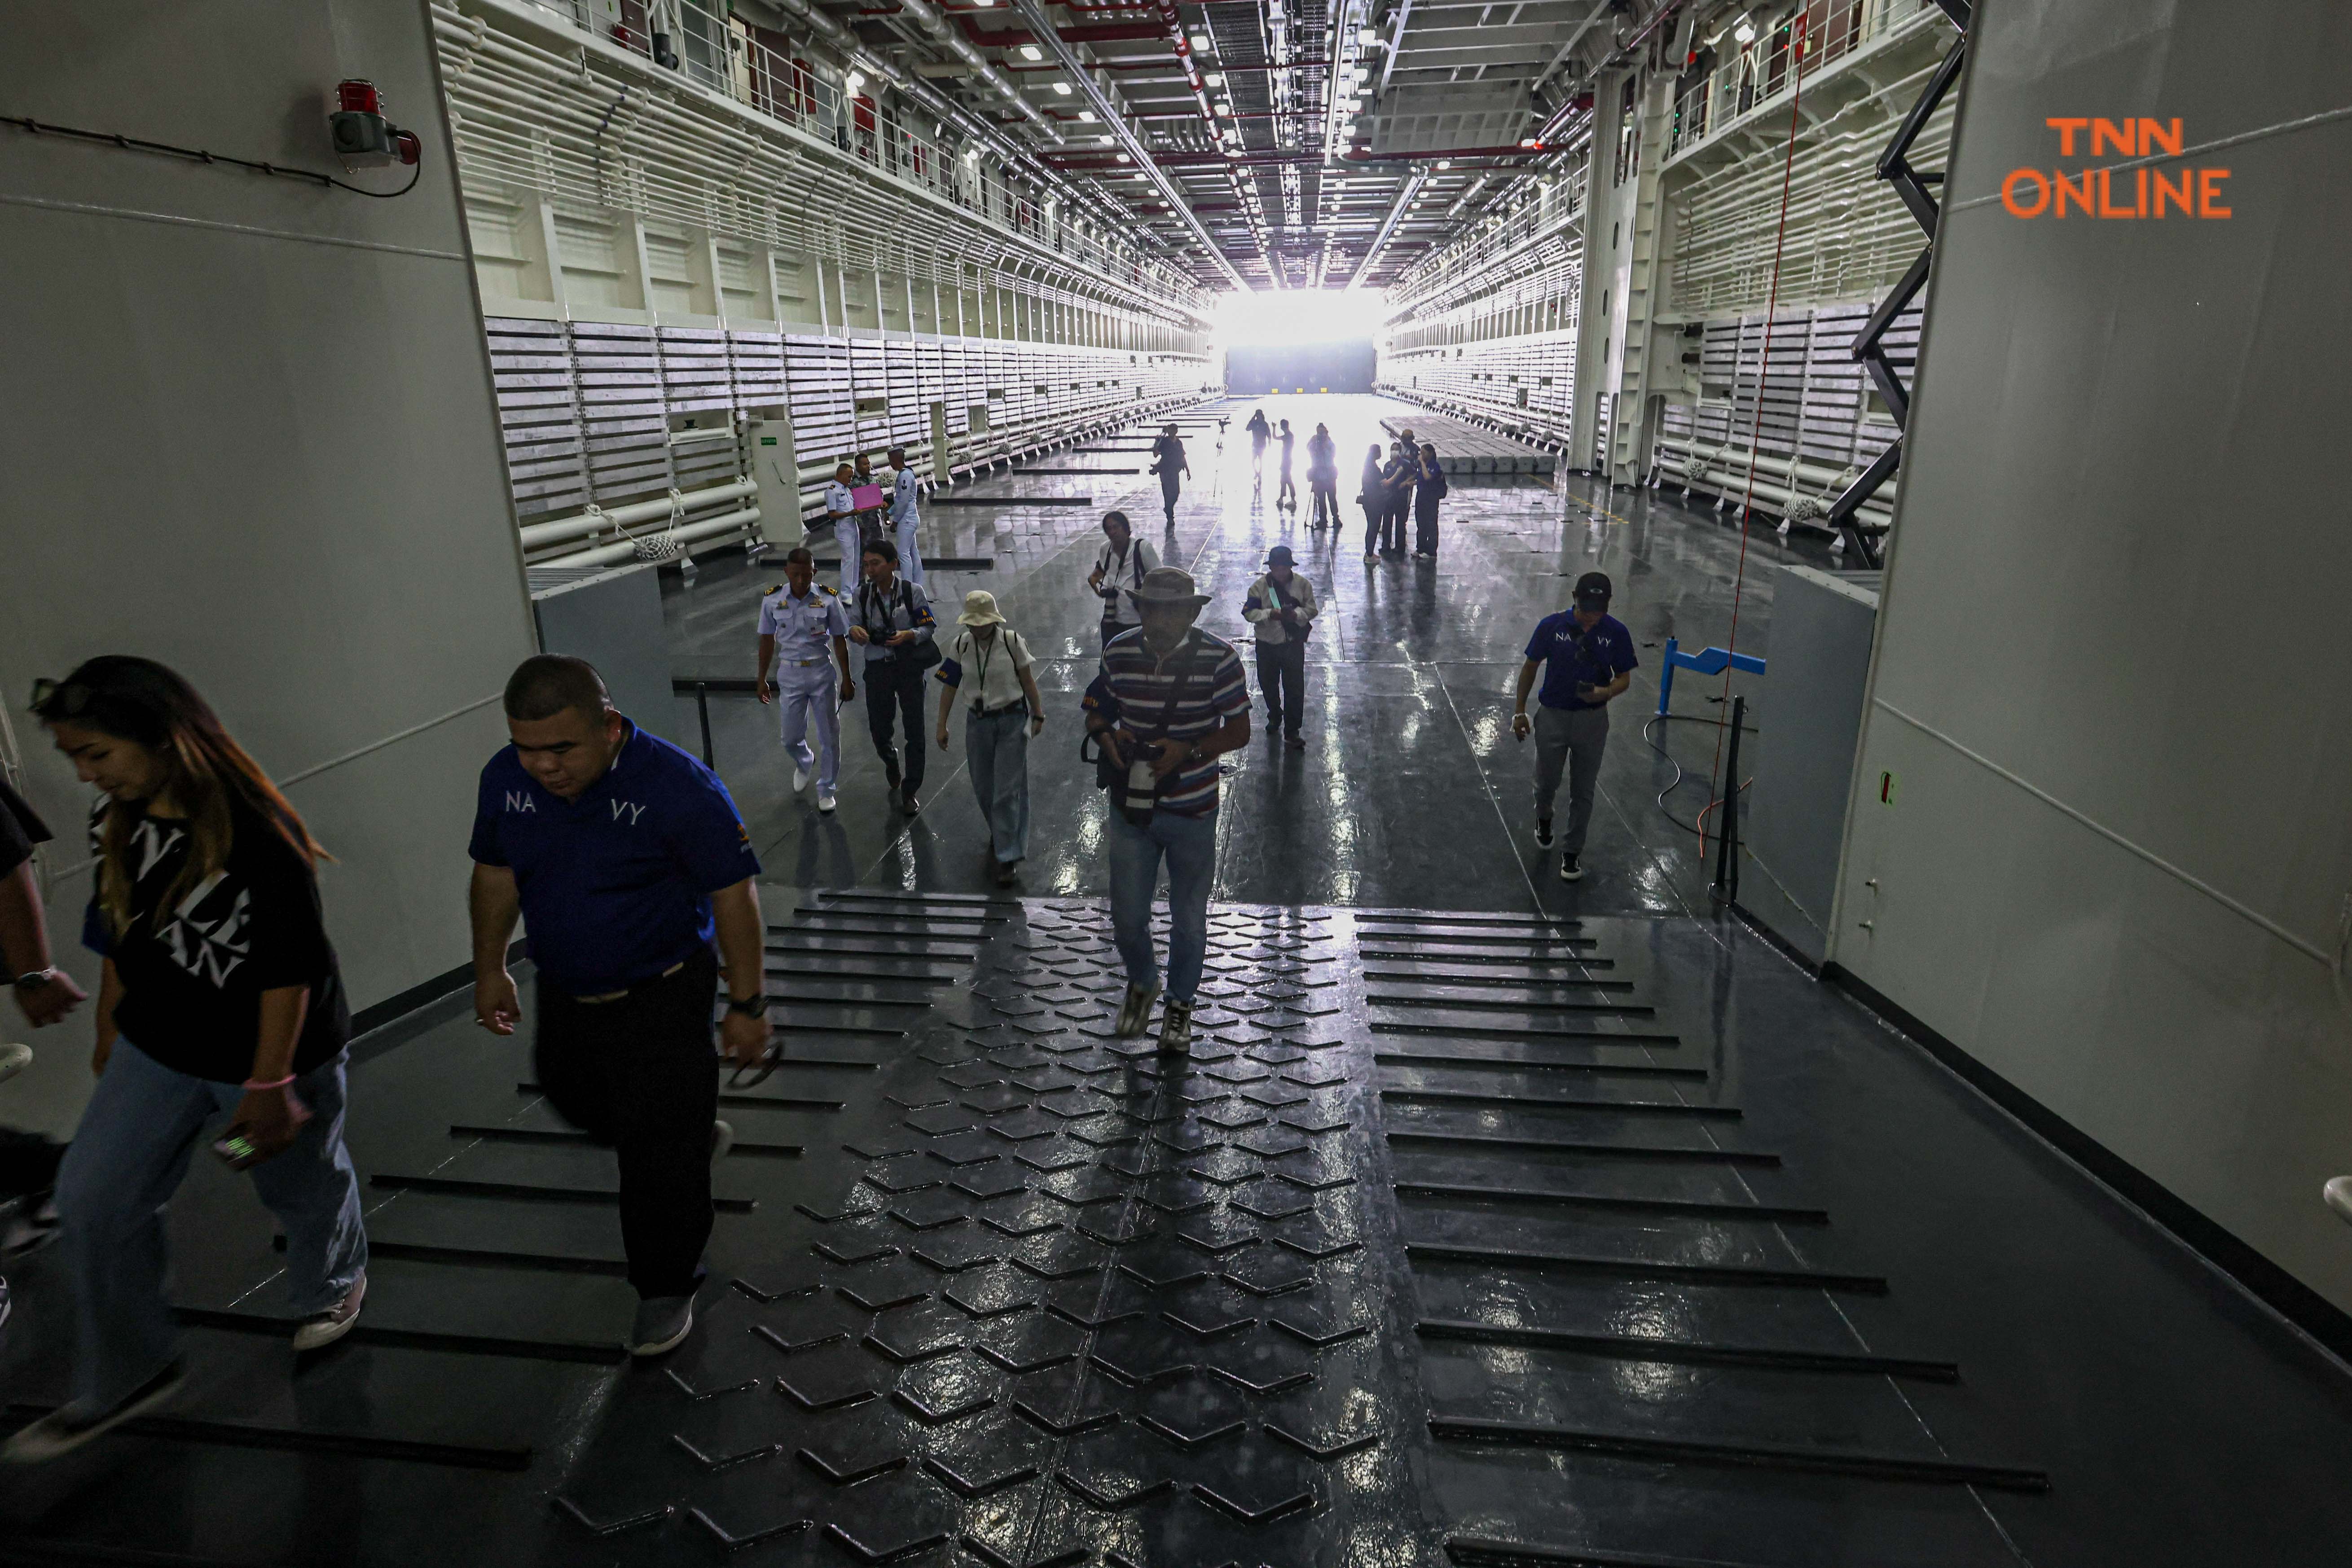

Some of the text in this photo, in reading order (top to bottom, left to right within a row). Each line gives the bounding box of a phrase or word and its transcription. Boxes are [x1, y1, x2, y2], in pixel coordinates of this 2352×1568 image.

[1556, 632, 1612, 647] NA VY
[506, 790, 646, 825] NA VY
